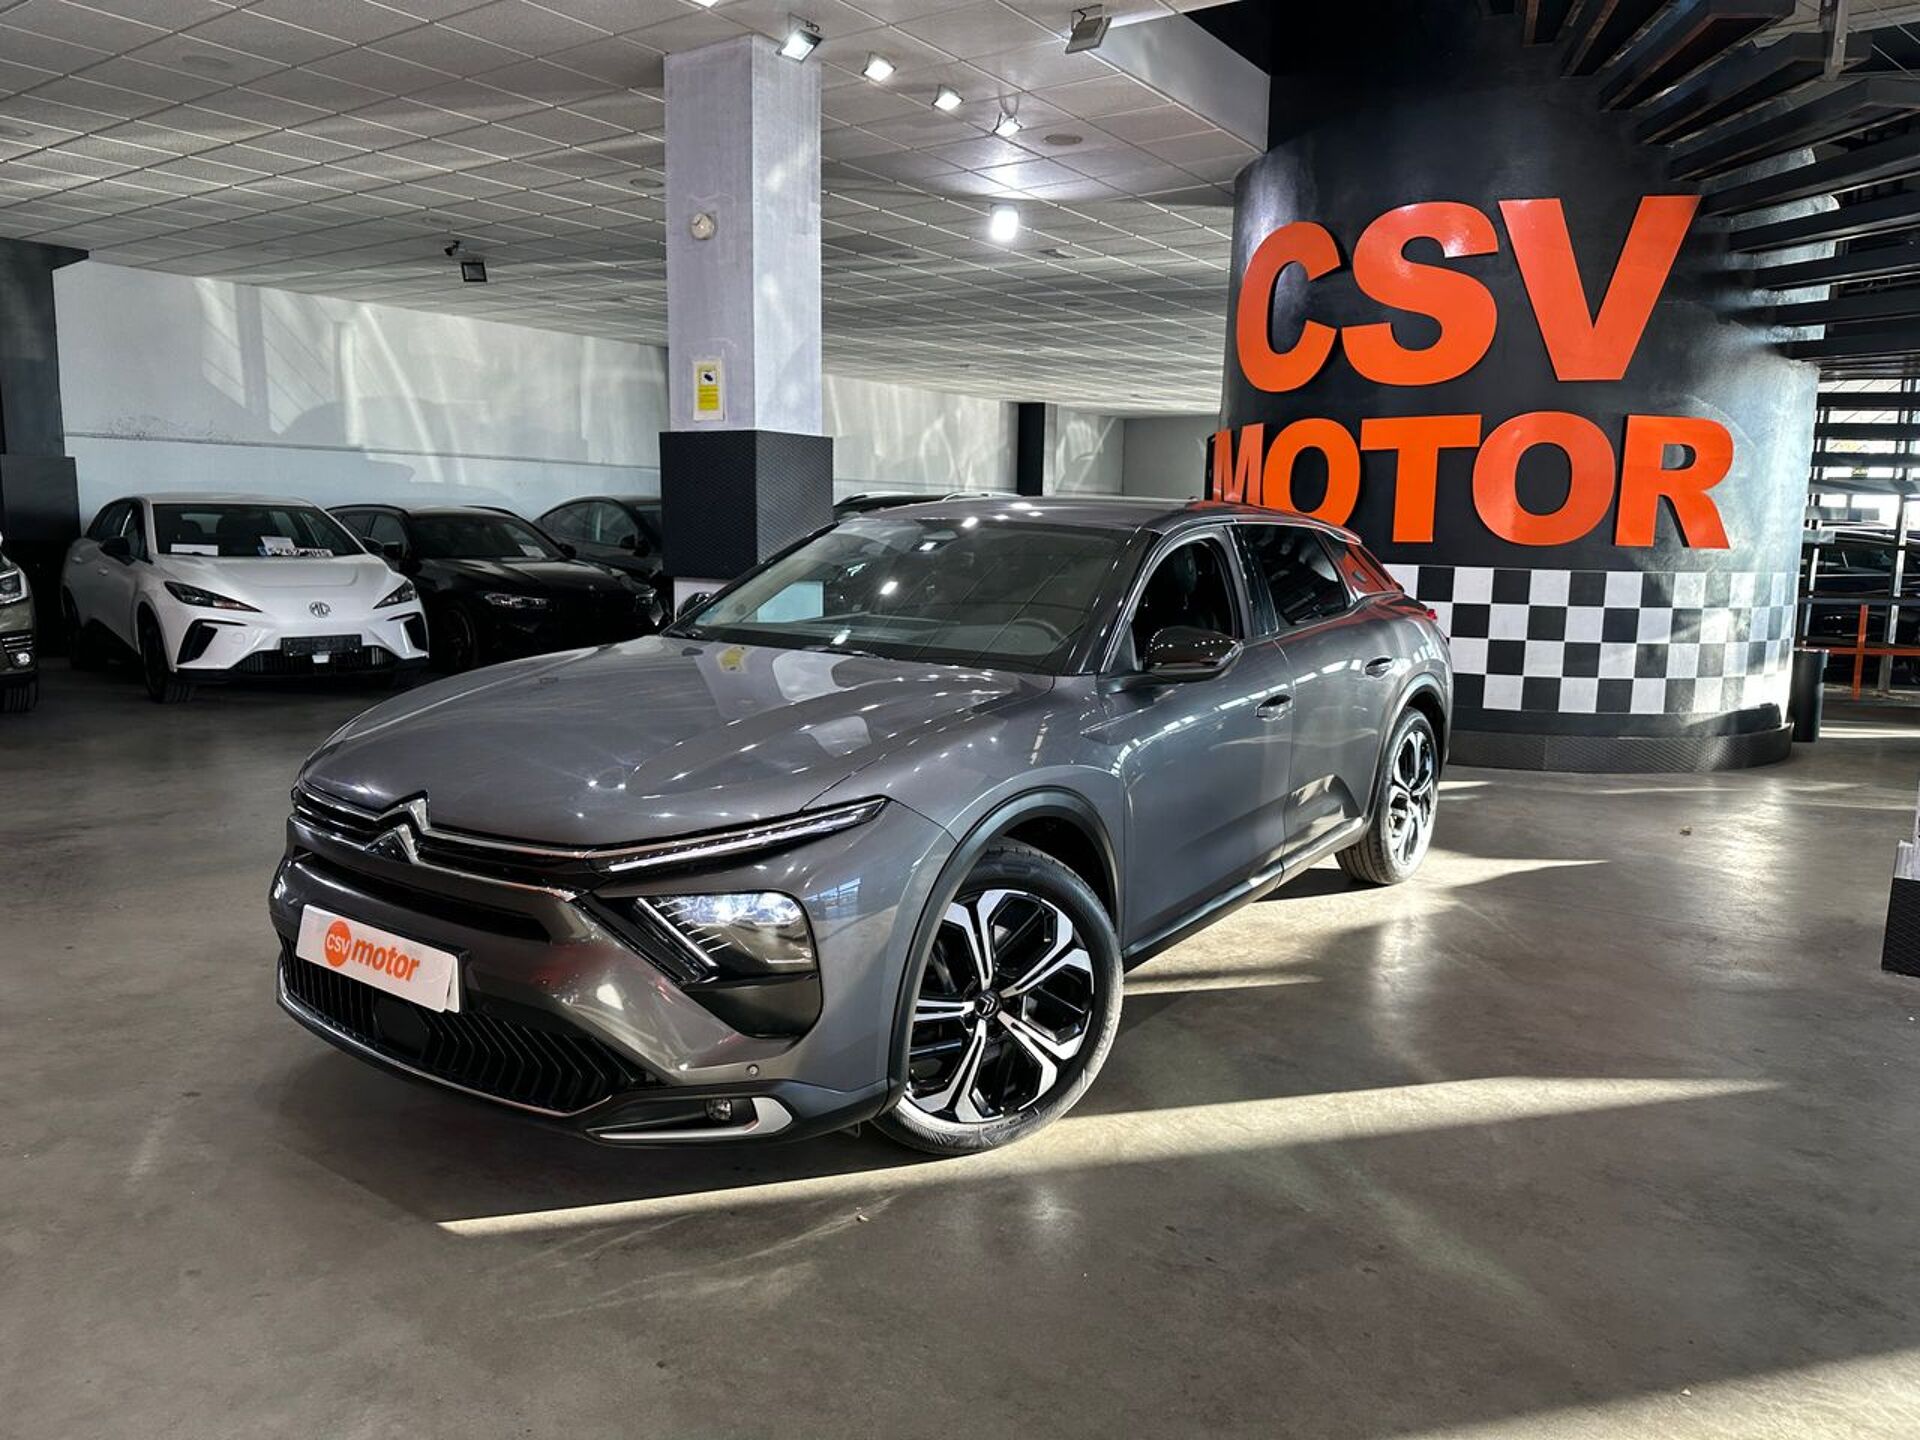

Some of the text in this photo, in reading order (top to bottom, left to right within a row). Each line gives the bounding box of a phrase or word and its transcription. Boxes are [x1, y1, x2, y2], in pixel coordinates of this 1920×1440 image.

[1236, 195, 1702, 393] CSV
[1212, 410, 1734, 550] MOTOR
[351, 938, 420, 981] motor
